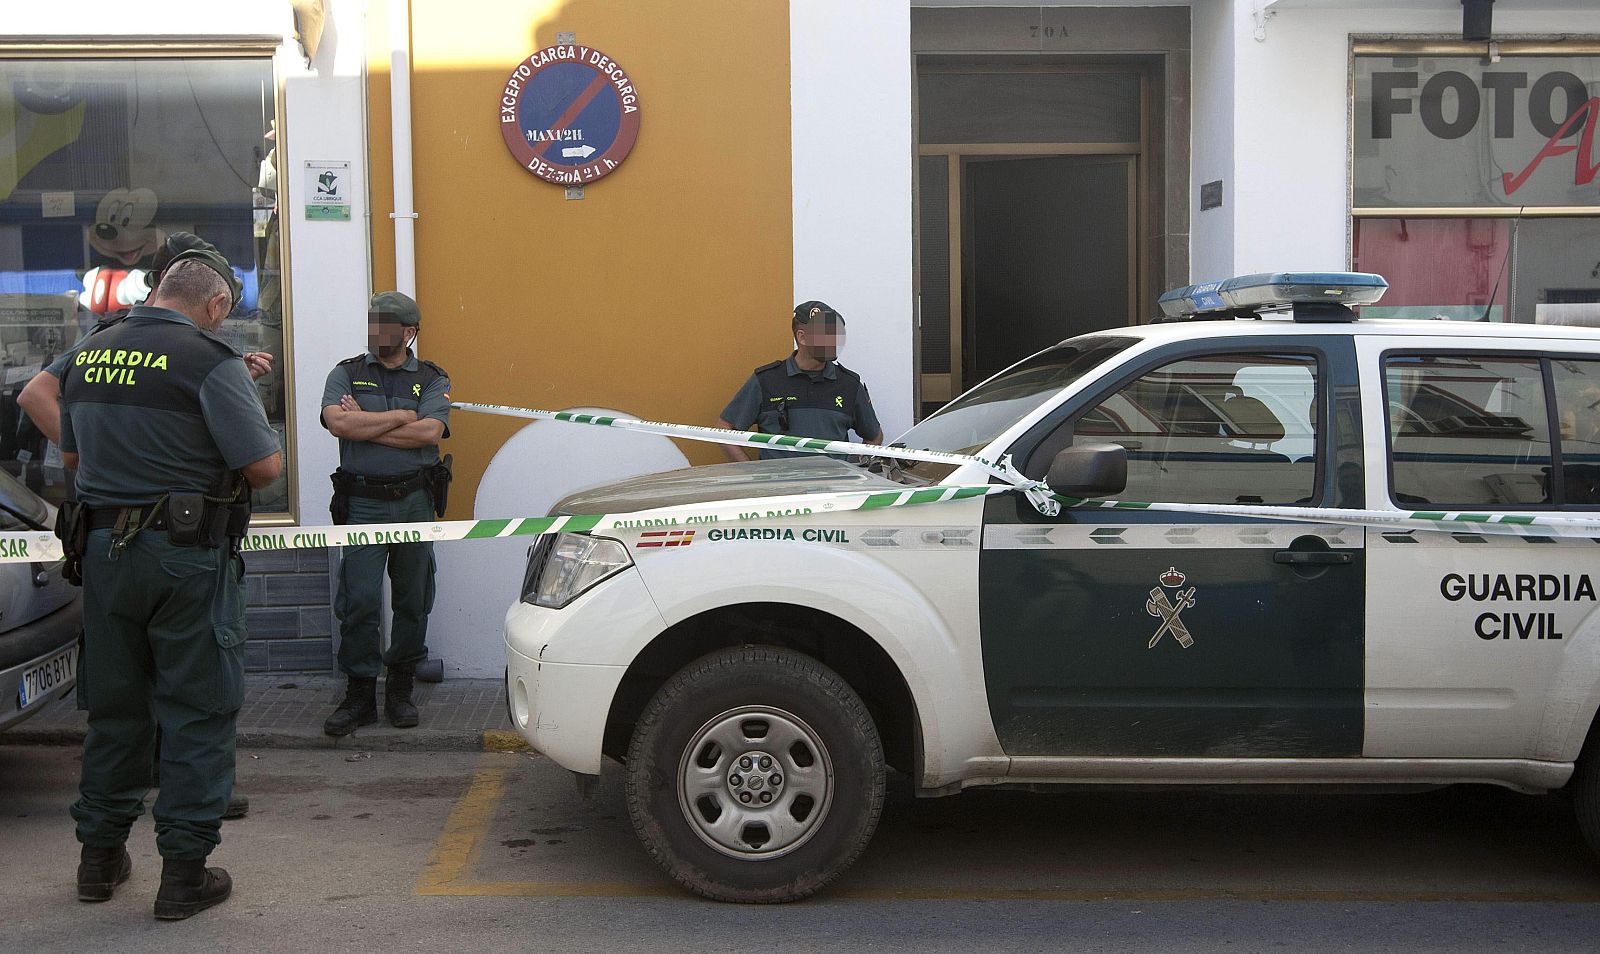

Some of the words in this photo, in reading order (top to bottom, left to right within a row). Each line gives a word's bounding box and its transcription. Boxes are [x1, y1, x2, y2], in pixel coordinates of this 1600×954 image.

[1030, 25, 1070, 38] 70A
[501, 65, 531, 123] EXCEPTO
[531, 45, 576, 68] CARGA
[580, 47, 589, 60] Y
[590, 51, 638, 114] DESCARGA
[1371, 70, 1590, 140] FOTO
[75, 349, 168, 371] GUARDIA
[84, 367, 136, 385] CIVIL
[346, 531, 370, 546] NO
[374, 530, 421, 545] PASAR
[707, 528, 796, 541] GUARDIA
[802, 528, 850, 543] CIVIL
[0, 538, 29, 558] SAR
[1440, 573, 1597, 601] GUARDIA
[1474, 612, 1563, 640] CIVIL
[25, 663, 53, 700] 7706
[54, 650, 72, 684] BTY
